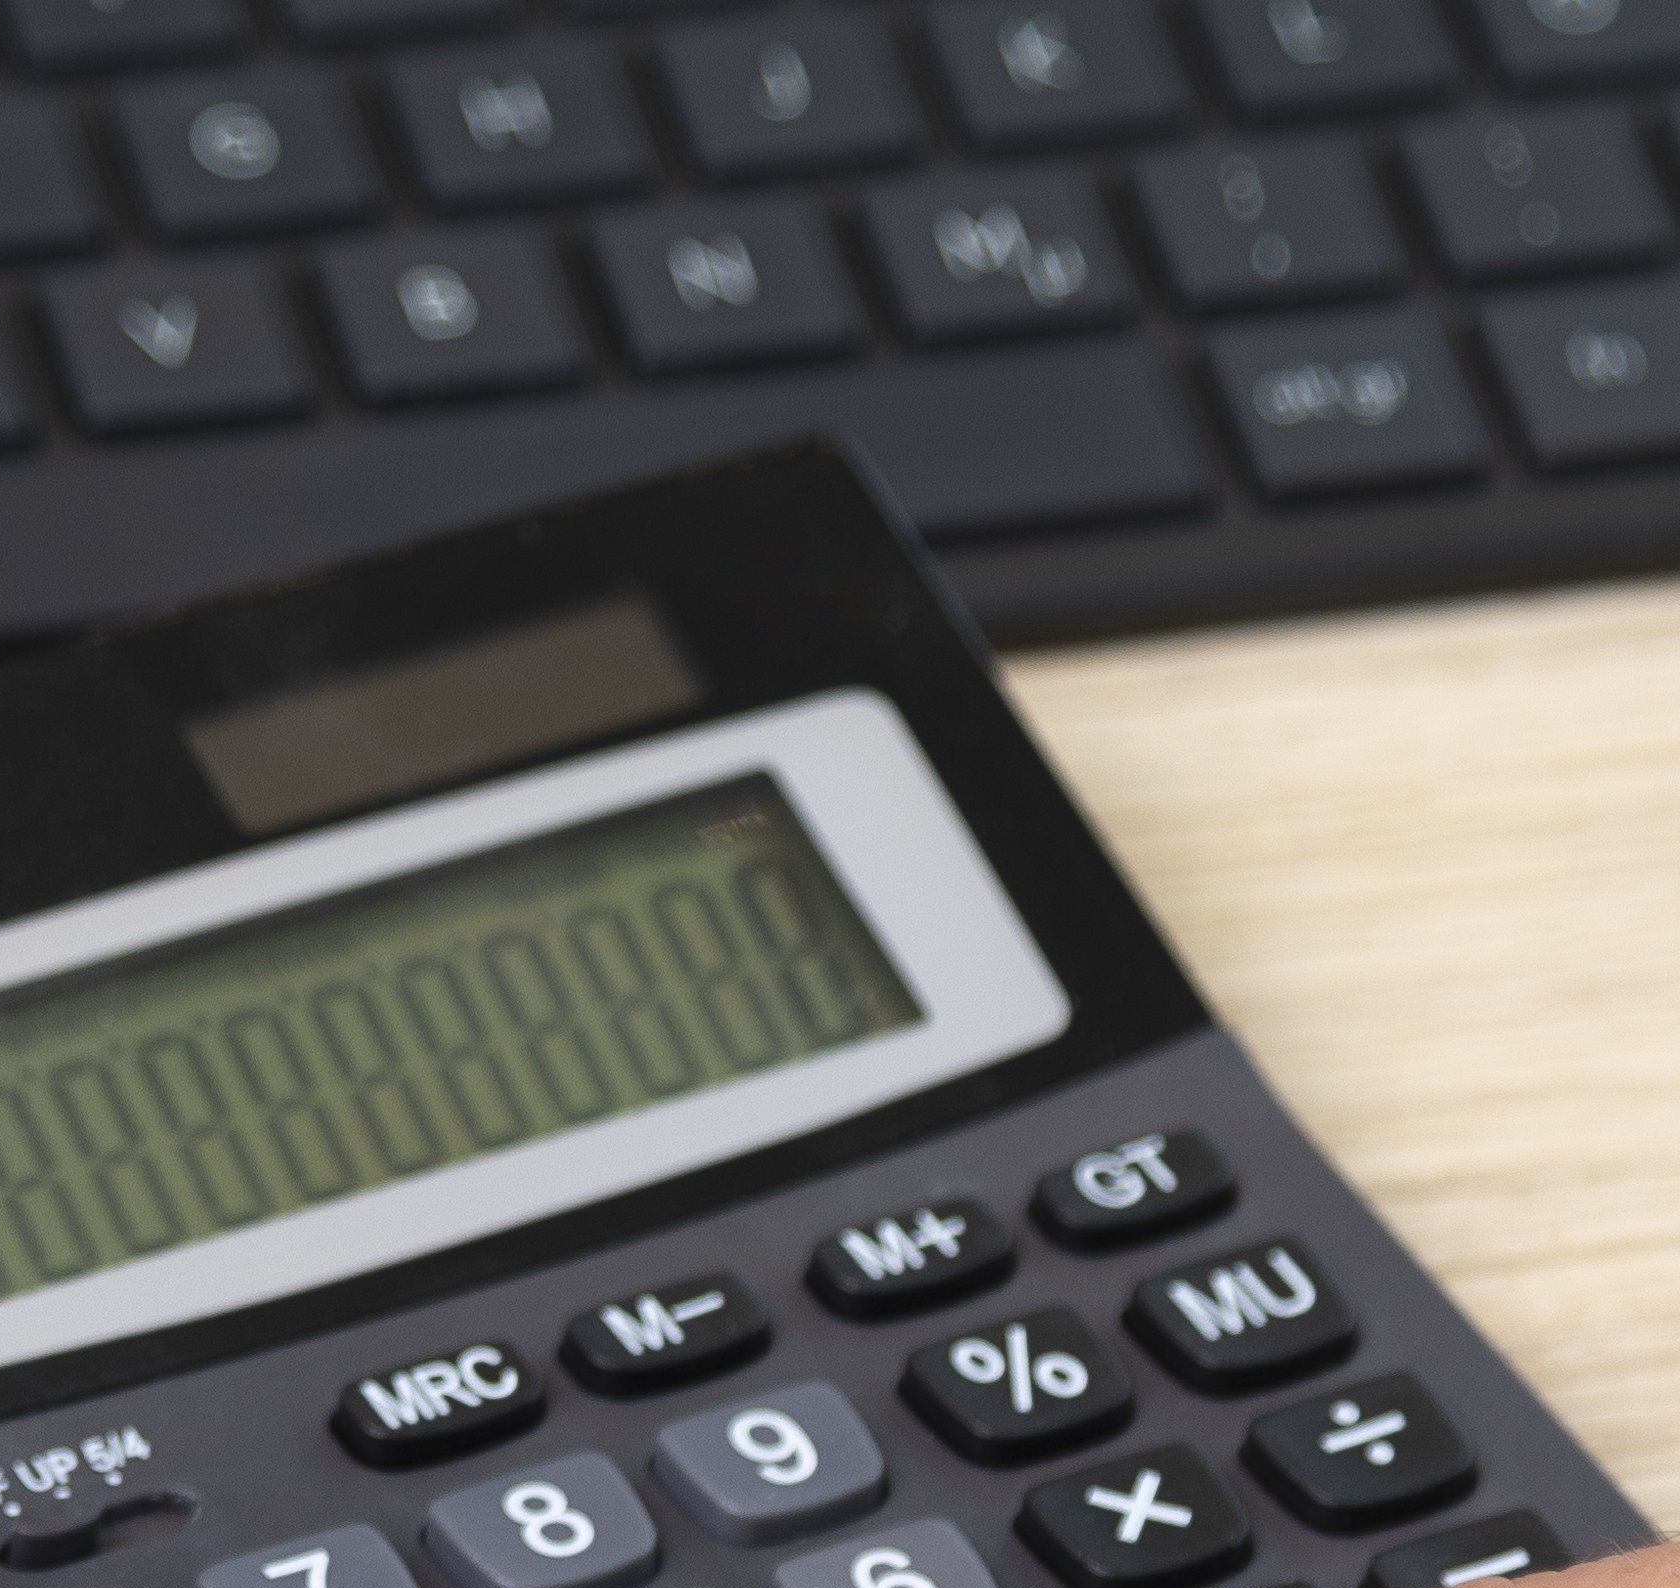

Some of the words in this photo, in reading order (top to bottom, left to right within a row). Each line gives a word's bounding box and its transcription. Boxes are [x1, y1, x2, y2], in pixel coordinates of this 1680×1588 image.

[1074, 1137, 1177, 1209] GT
[841, 1211, 965, 1280] M+
[1169, 1251, 1317, 1341] MU
[360, 1346, 520, 1431] MRC
[13, 1448, 79, 1493] UP
[728, 1410, 819, 1485] 9
[503, 1482, 596, 1559] 8
